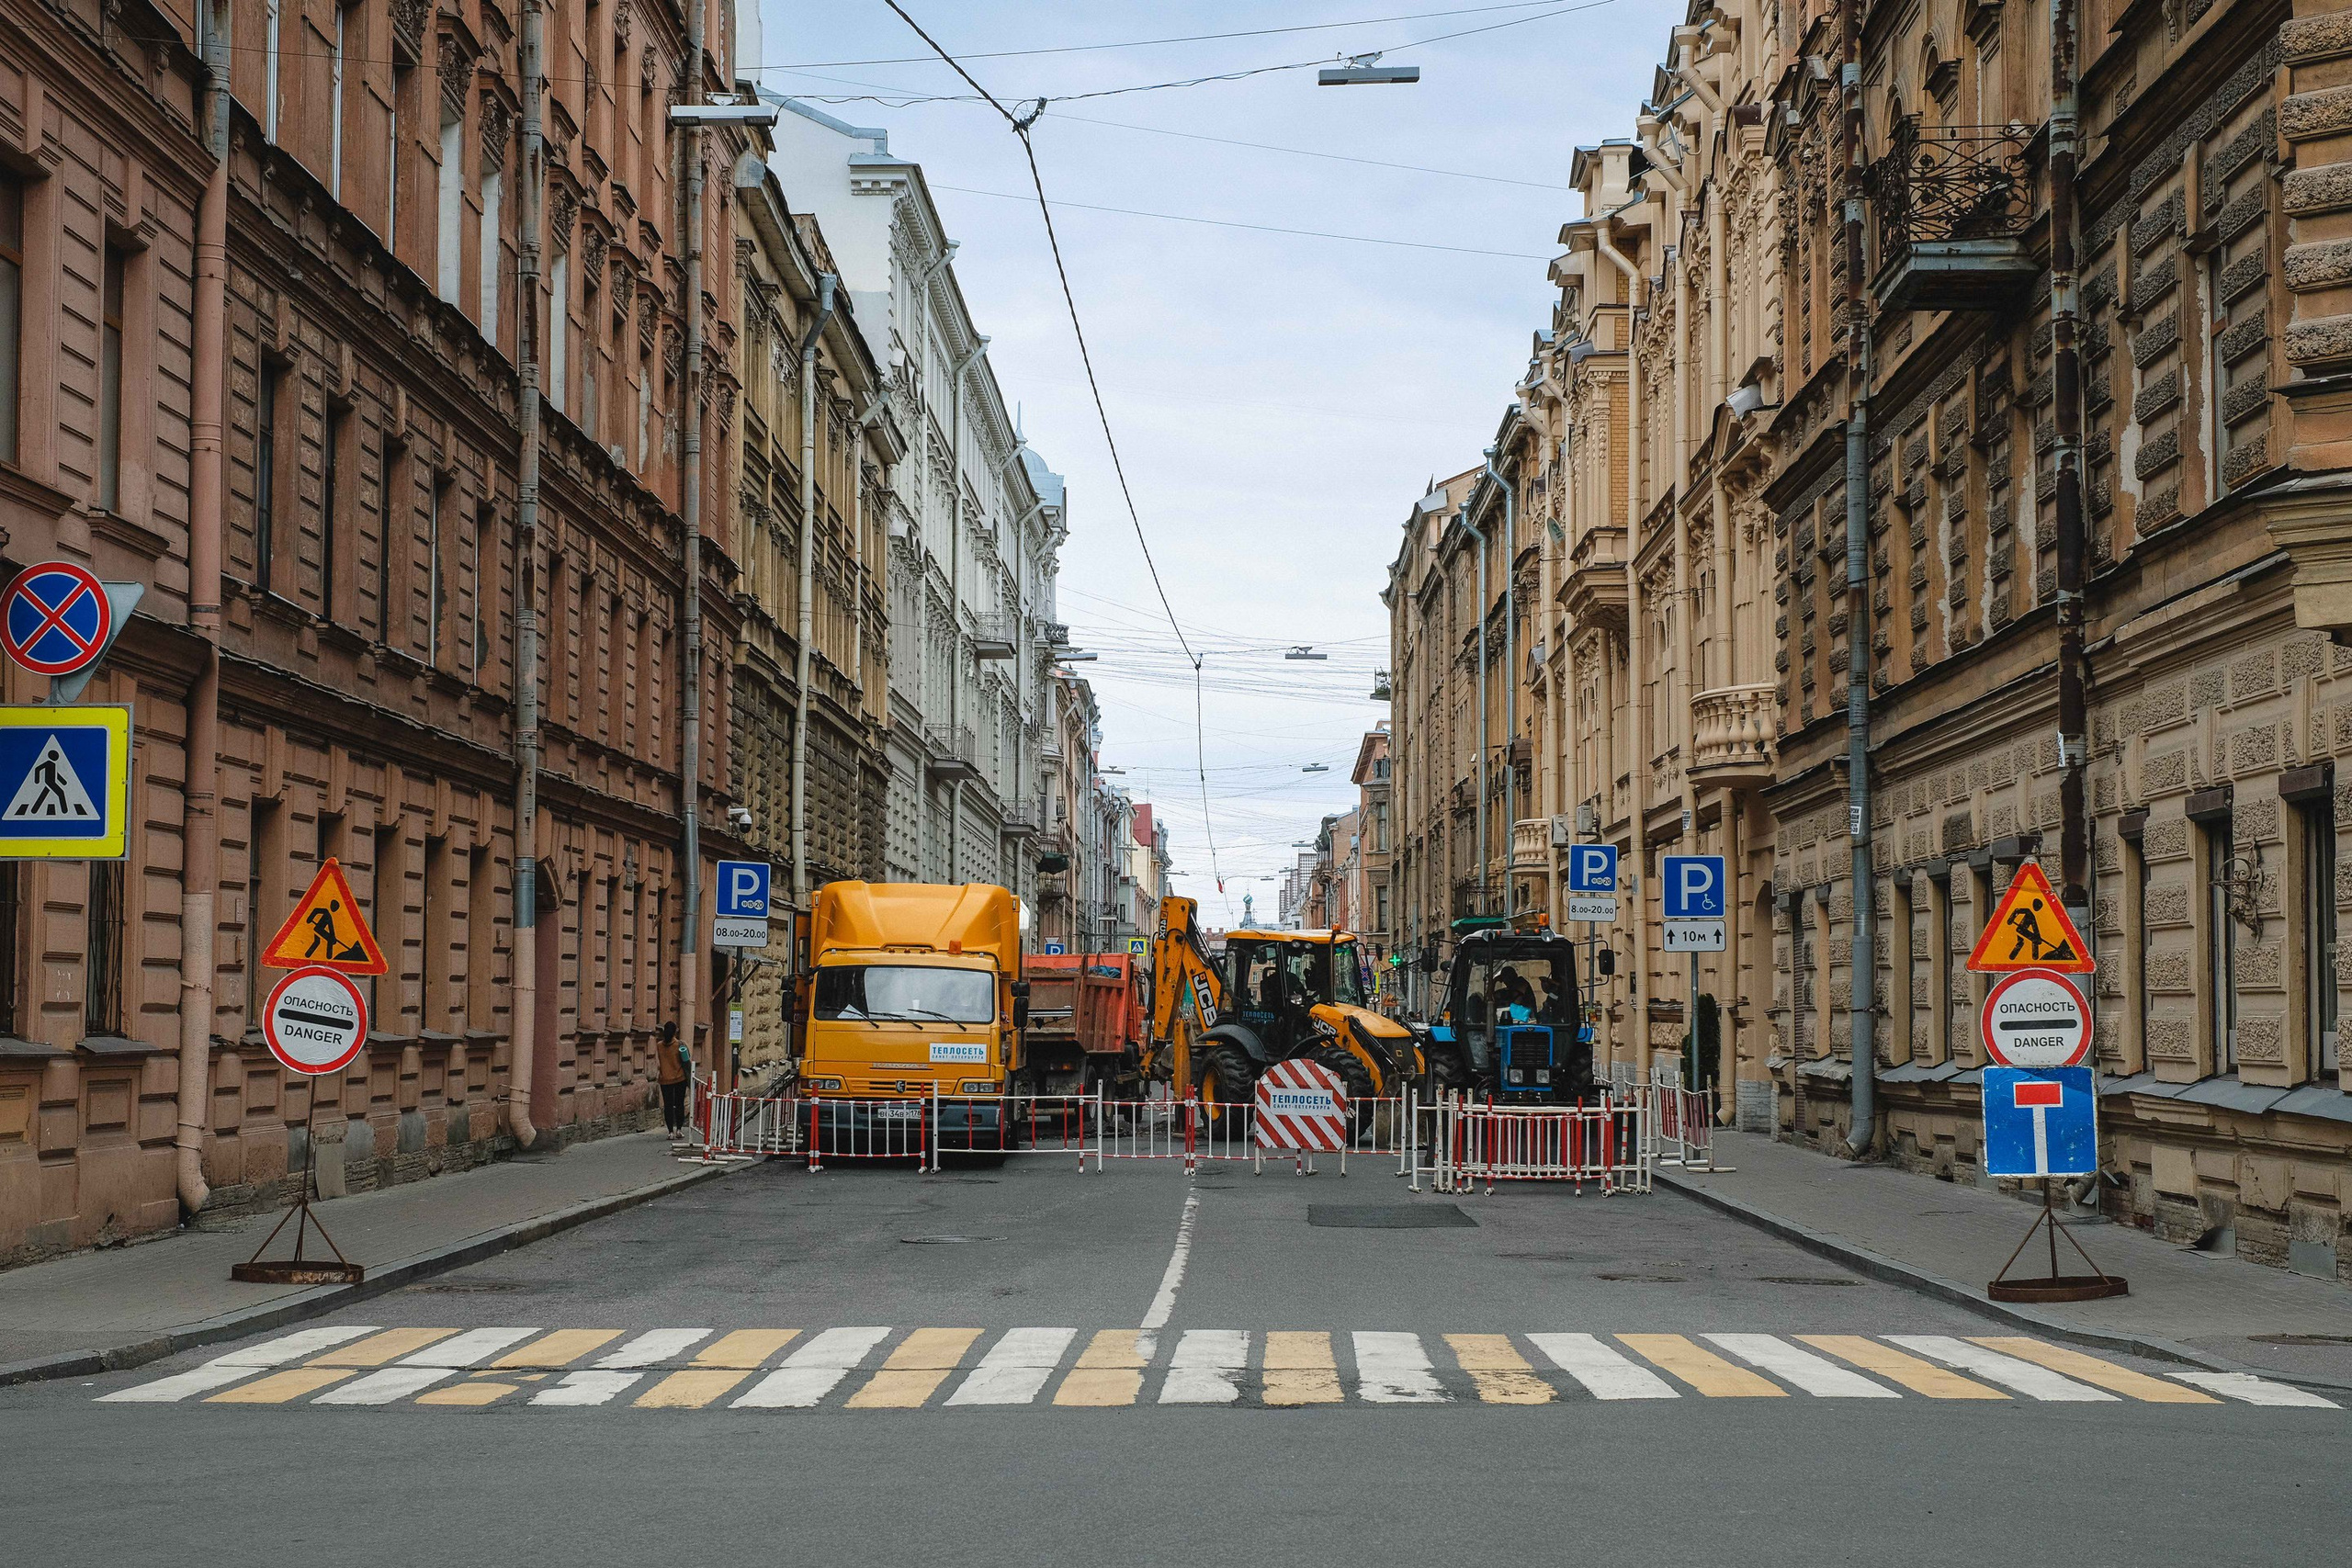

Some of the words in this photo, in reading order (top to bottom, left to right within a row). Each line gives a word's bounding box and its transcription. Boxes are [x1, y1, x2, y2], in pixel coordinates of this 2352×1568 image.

[1583, 850, 1608, 886] P
[731, 868, 760, 909] P
[1680, 863, 1713, 910] P
[1571, 905, 1613, 914] 8.00-20.00
[717, 927, 765, 938] 08.00-20.00
[284, 995, 354, 1016] ОПАСНОСТЬ
[1193, 975, 1217, 1028] JCB
[1999, 1002, 2075, 1013] ОПАСНОСТЬ
[284, 1024, 343, 1044] DANGER
[2014, 1036, 2064, 1047] DANGER
[932, 1046, 984, 1055] ТЕПЛОСЕТЬ
[1272, 1094, 1331, 1105] ТЕПЛОСЕТЬ
